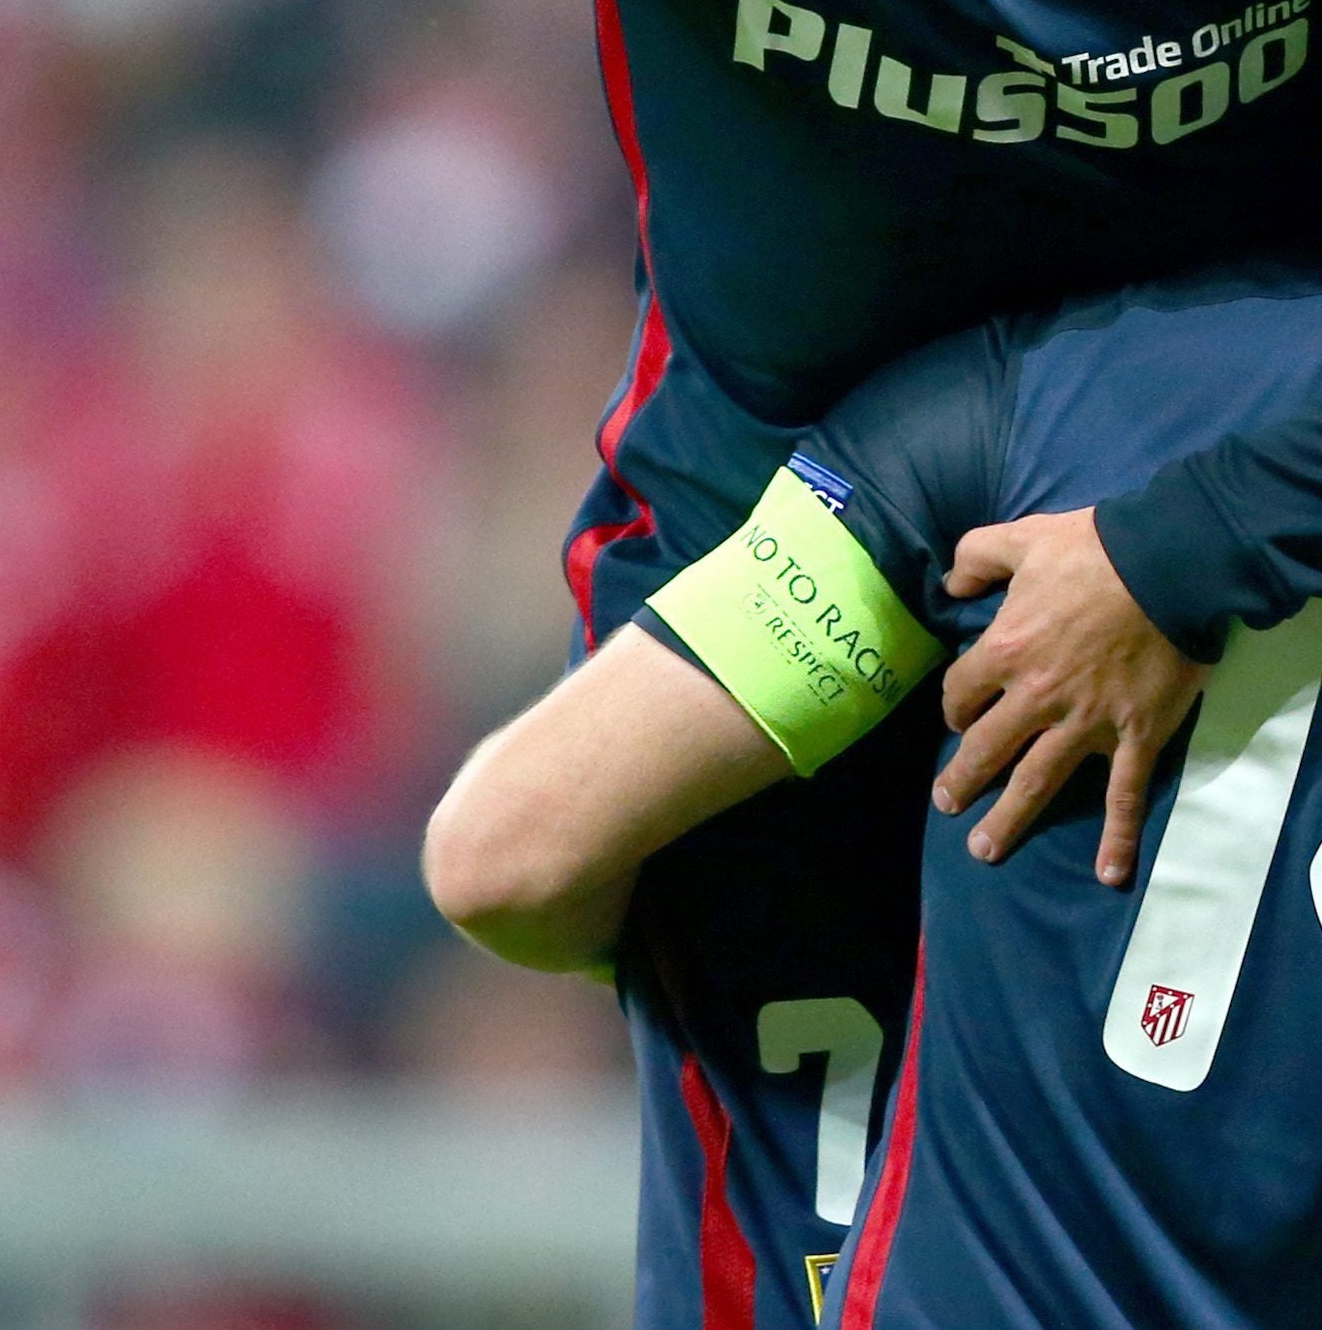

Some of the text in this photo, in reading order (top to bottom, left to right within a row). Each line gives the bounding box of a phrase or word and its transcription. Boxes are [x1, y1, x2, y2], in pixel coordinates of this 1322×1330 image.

[1061, 35, 1183, 85] Trade
[776, 556, 818, 604] TO
[765, 615, 846, 701] RESPECT
[756, 996, 884, 1226] 7
